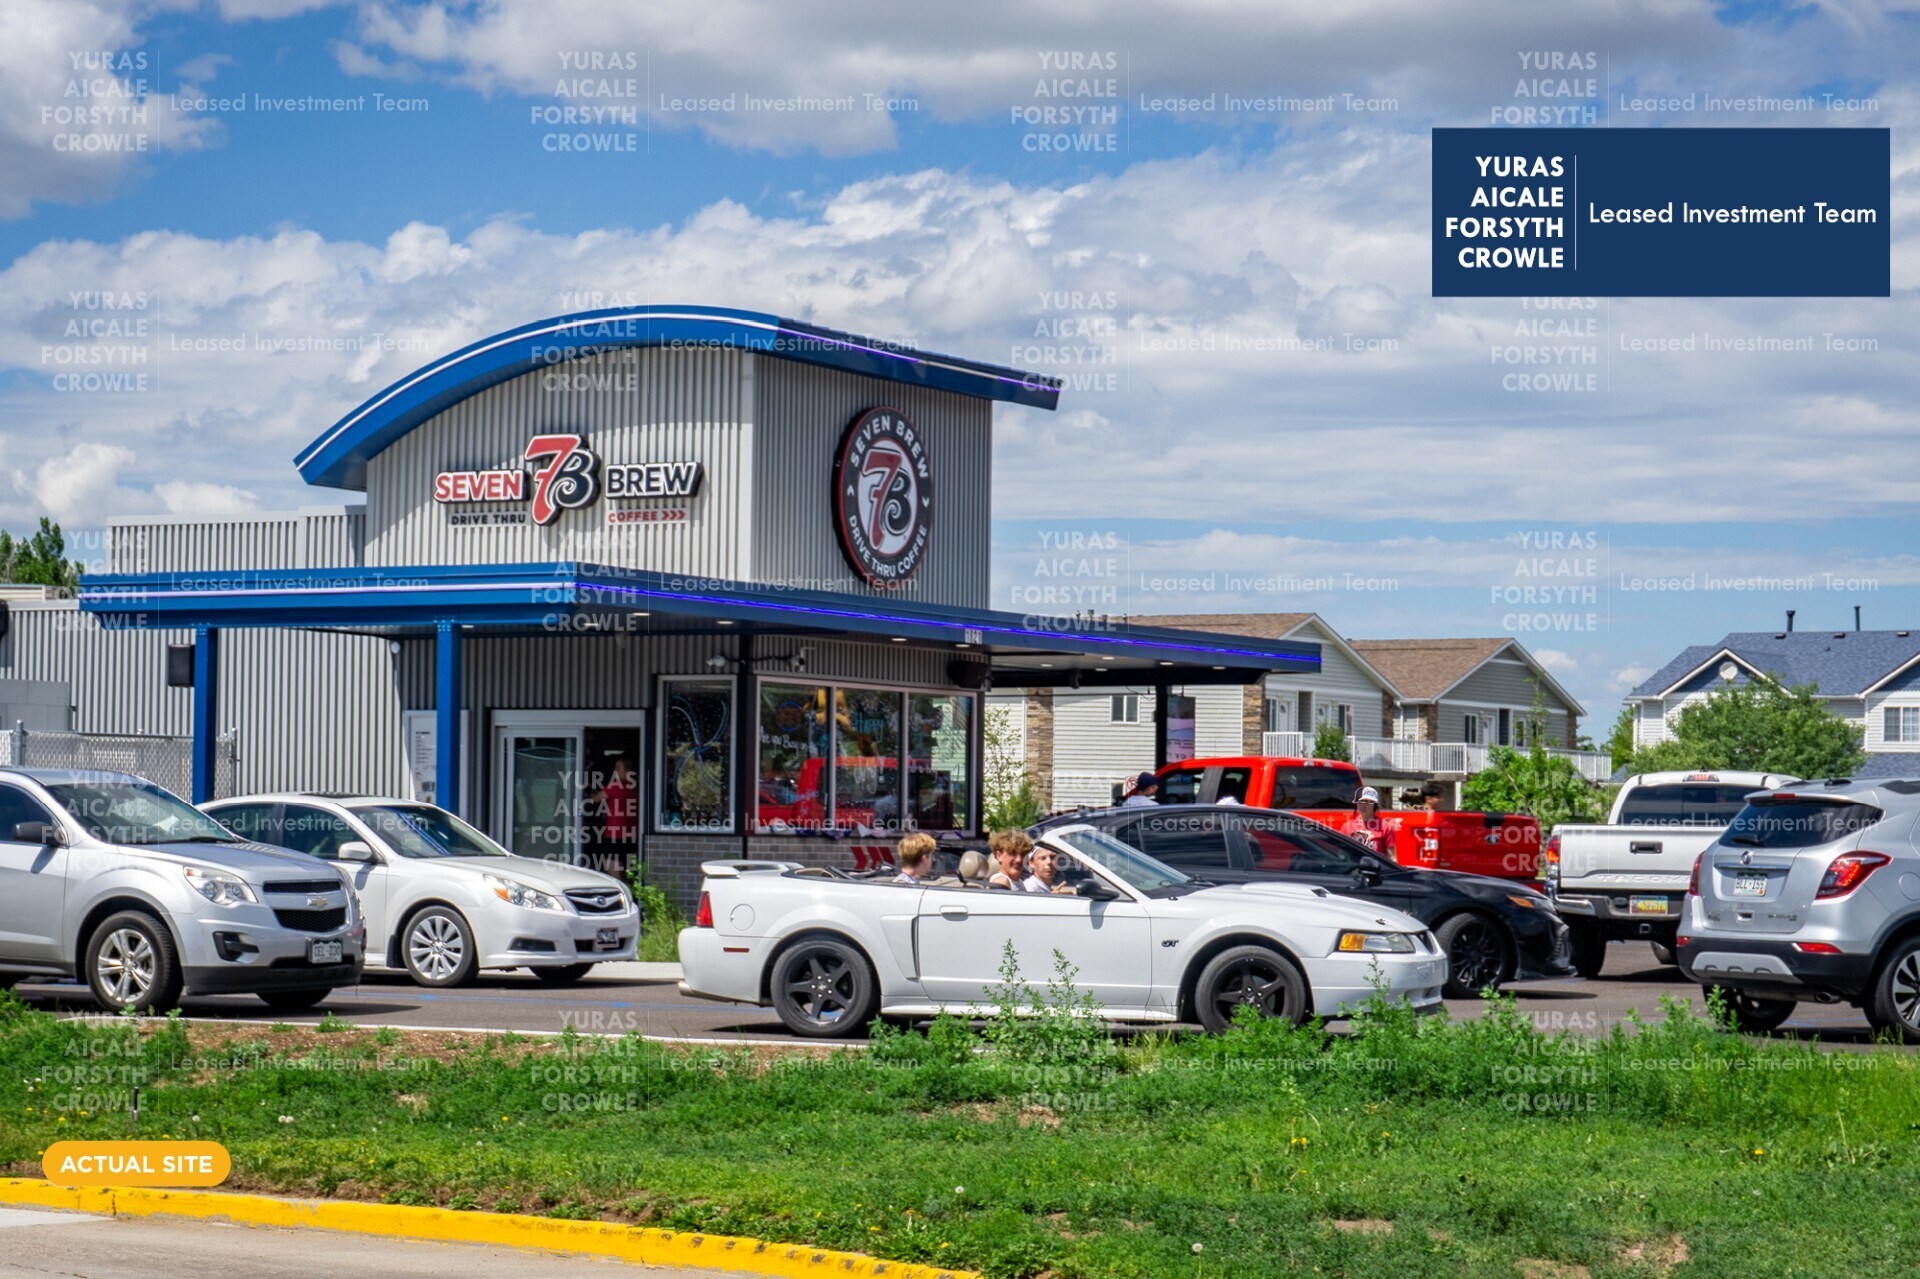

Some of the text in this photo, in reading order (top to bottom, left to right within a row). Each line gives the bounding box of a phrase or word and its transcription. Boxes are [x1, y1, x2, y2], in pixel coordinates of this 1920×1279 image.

[850, 415, 930, 478] SEVEN BREW
[435, 470, 525, 502] SEVEN
[606, 462, 701, 500] BREW
[451, 513, 526, 525] DRIVE THRU
[608, 512, 658, 523] COFFEE
[848, 514, 928, 578] DRIVE THRU COFFEE
